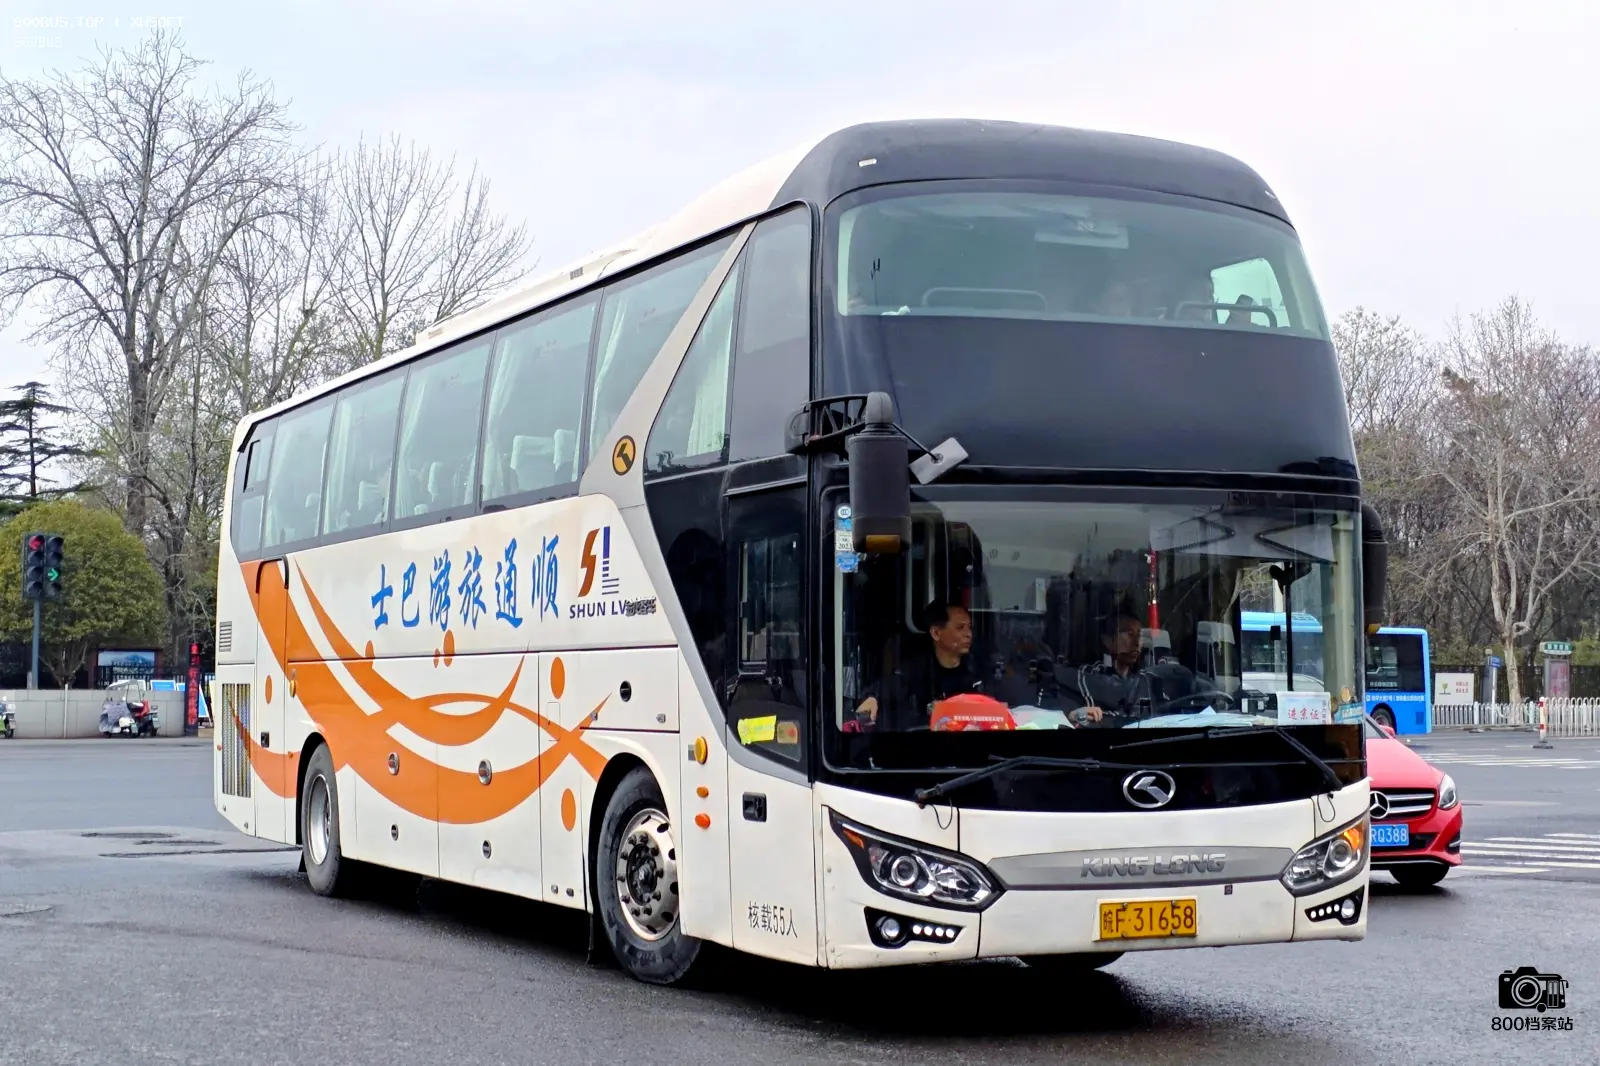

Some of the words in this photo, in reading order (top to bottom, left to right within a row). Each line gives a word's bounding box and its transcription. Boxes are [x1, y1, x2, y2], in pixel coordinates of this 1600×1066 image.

[569, 601, 606, 619] SHUN
[1081, 856, 1149, 877] KING
[1153, 853, 1226, 875] LONG
[748, 901, 798, 939] 核载55人
